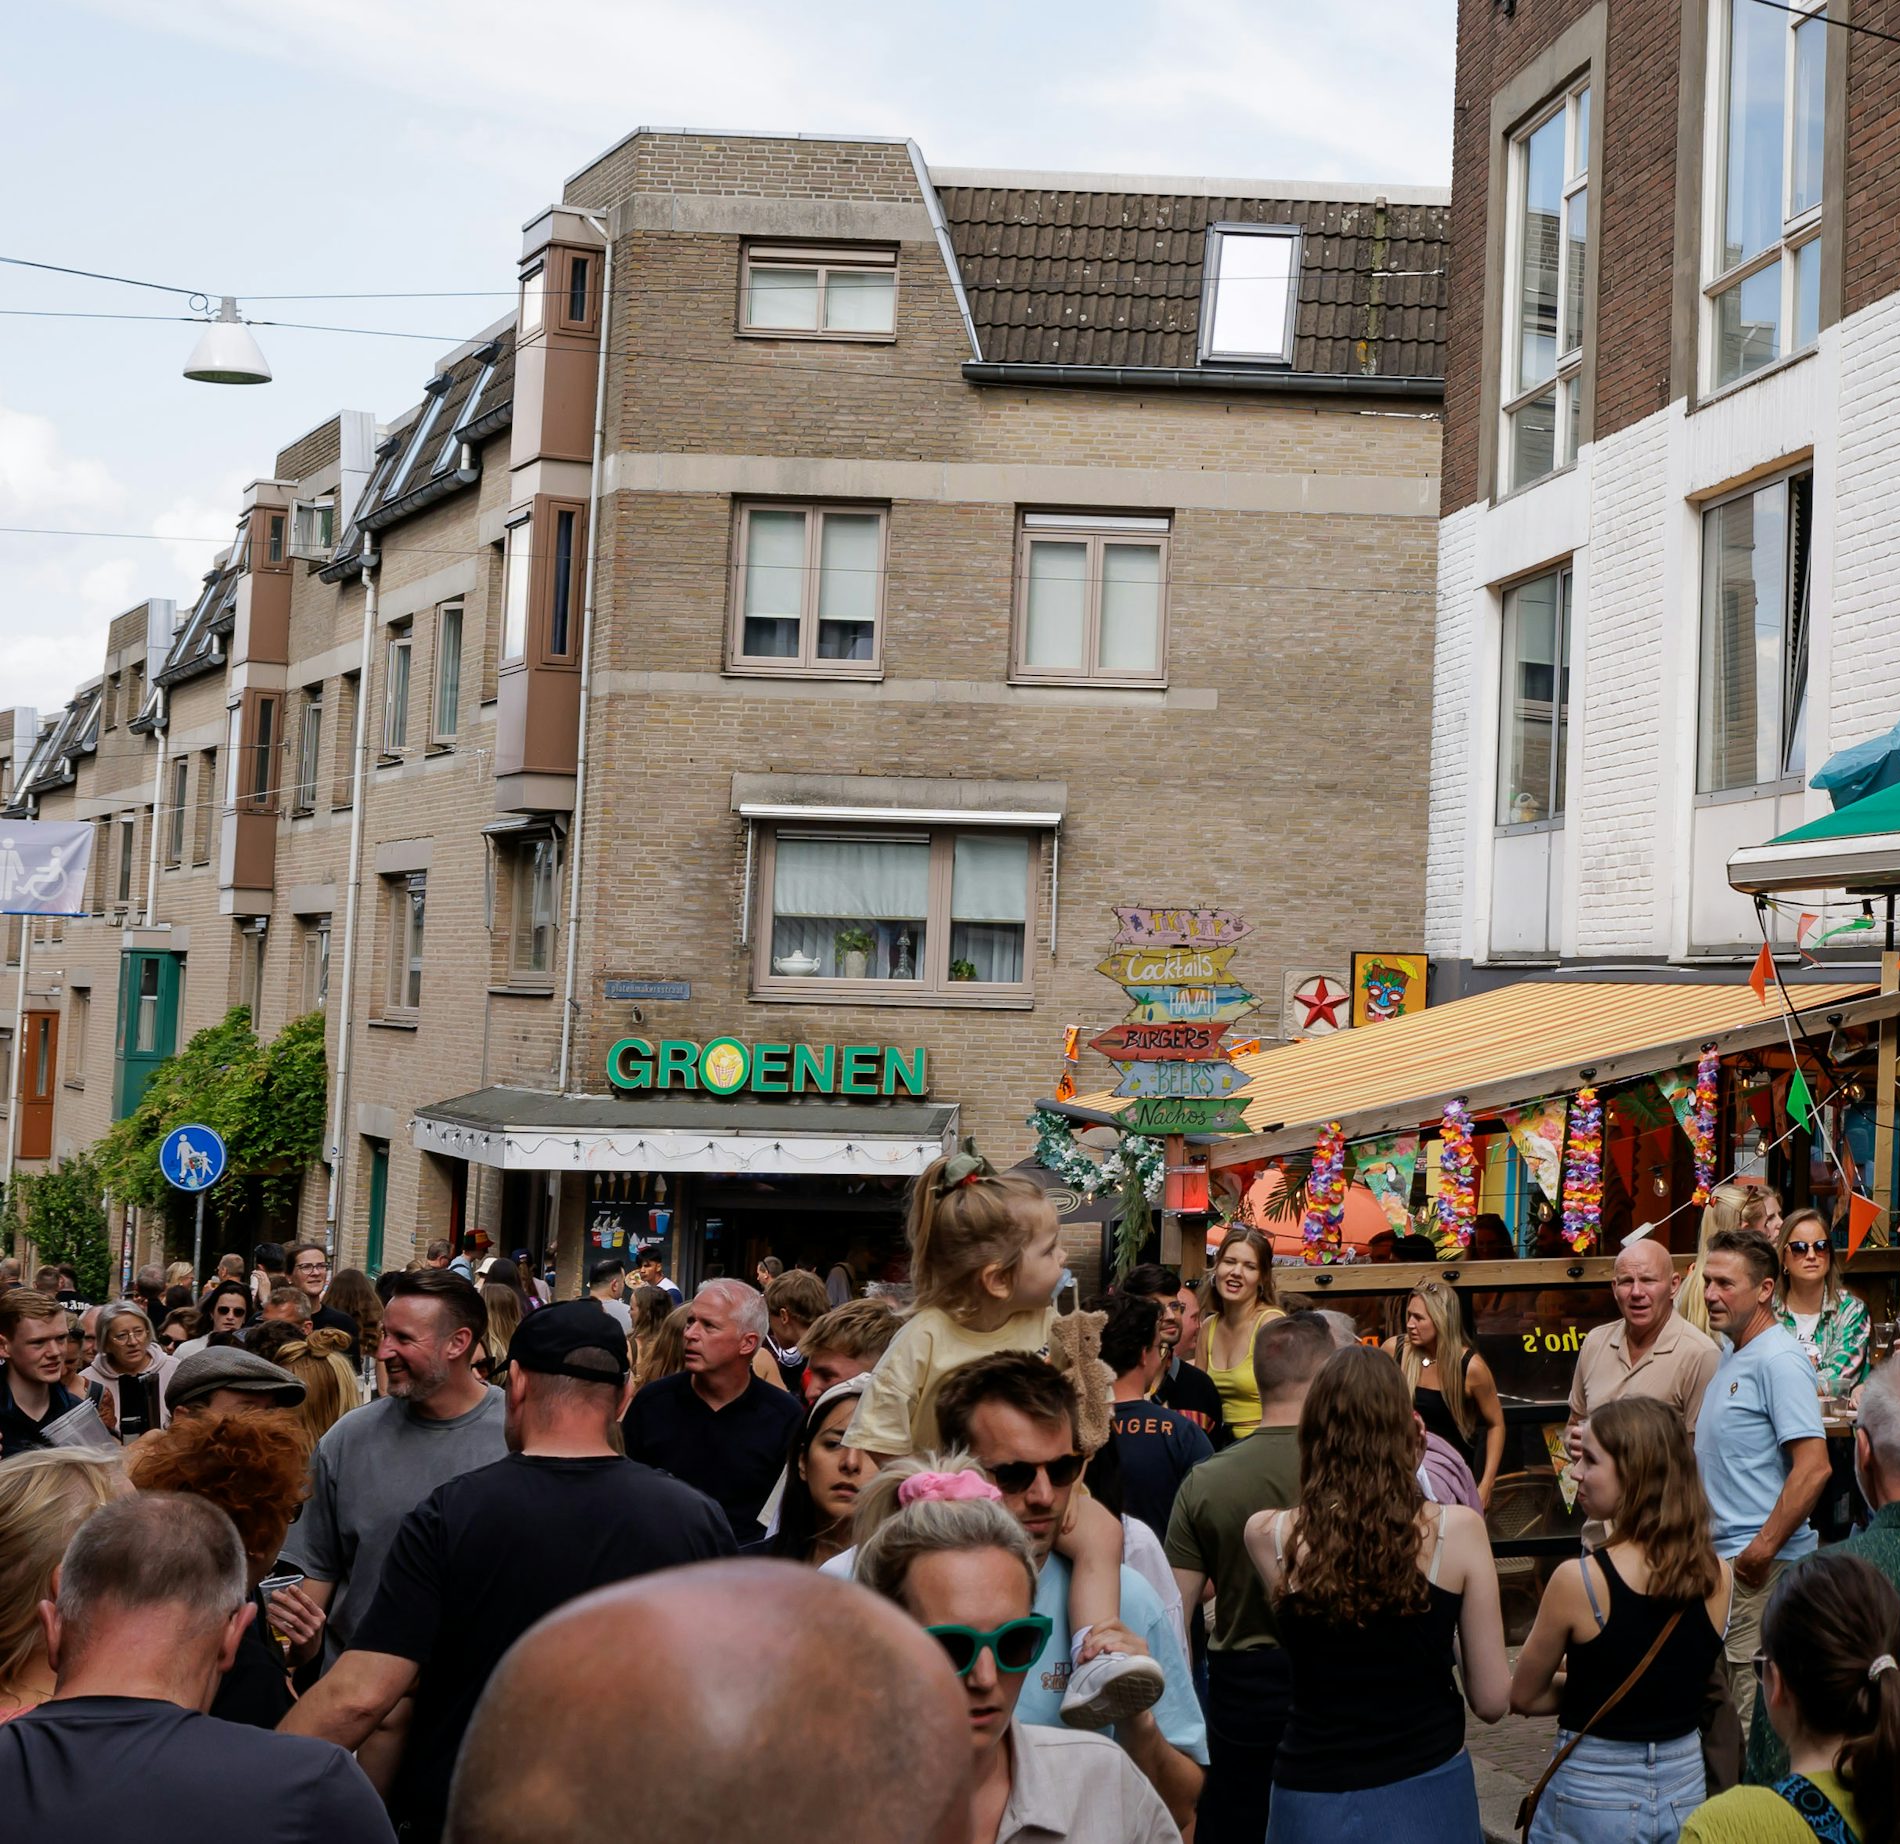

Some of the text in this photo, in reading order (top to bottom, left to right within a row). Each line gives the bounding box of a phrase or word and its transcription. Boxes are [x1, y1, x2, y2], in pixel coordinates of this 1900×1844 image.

[1151, 910, 1186, 933] TIKI
[1127, 953, 1213, 982] Cocktails
[1122, 1029, 1211, 1051] BURGERS
[606, 1036, 929, 1096] GROENEN
[1157, 1062, 1214, 1095] BEERS
[1138, 1101, 1209, 1128] Nachos
